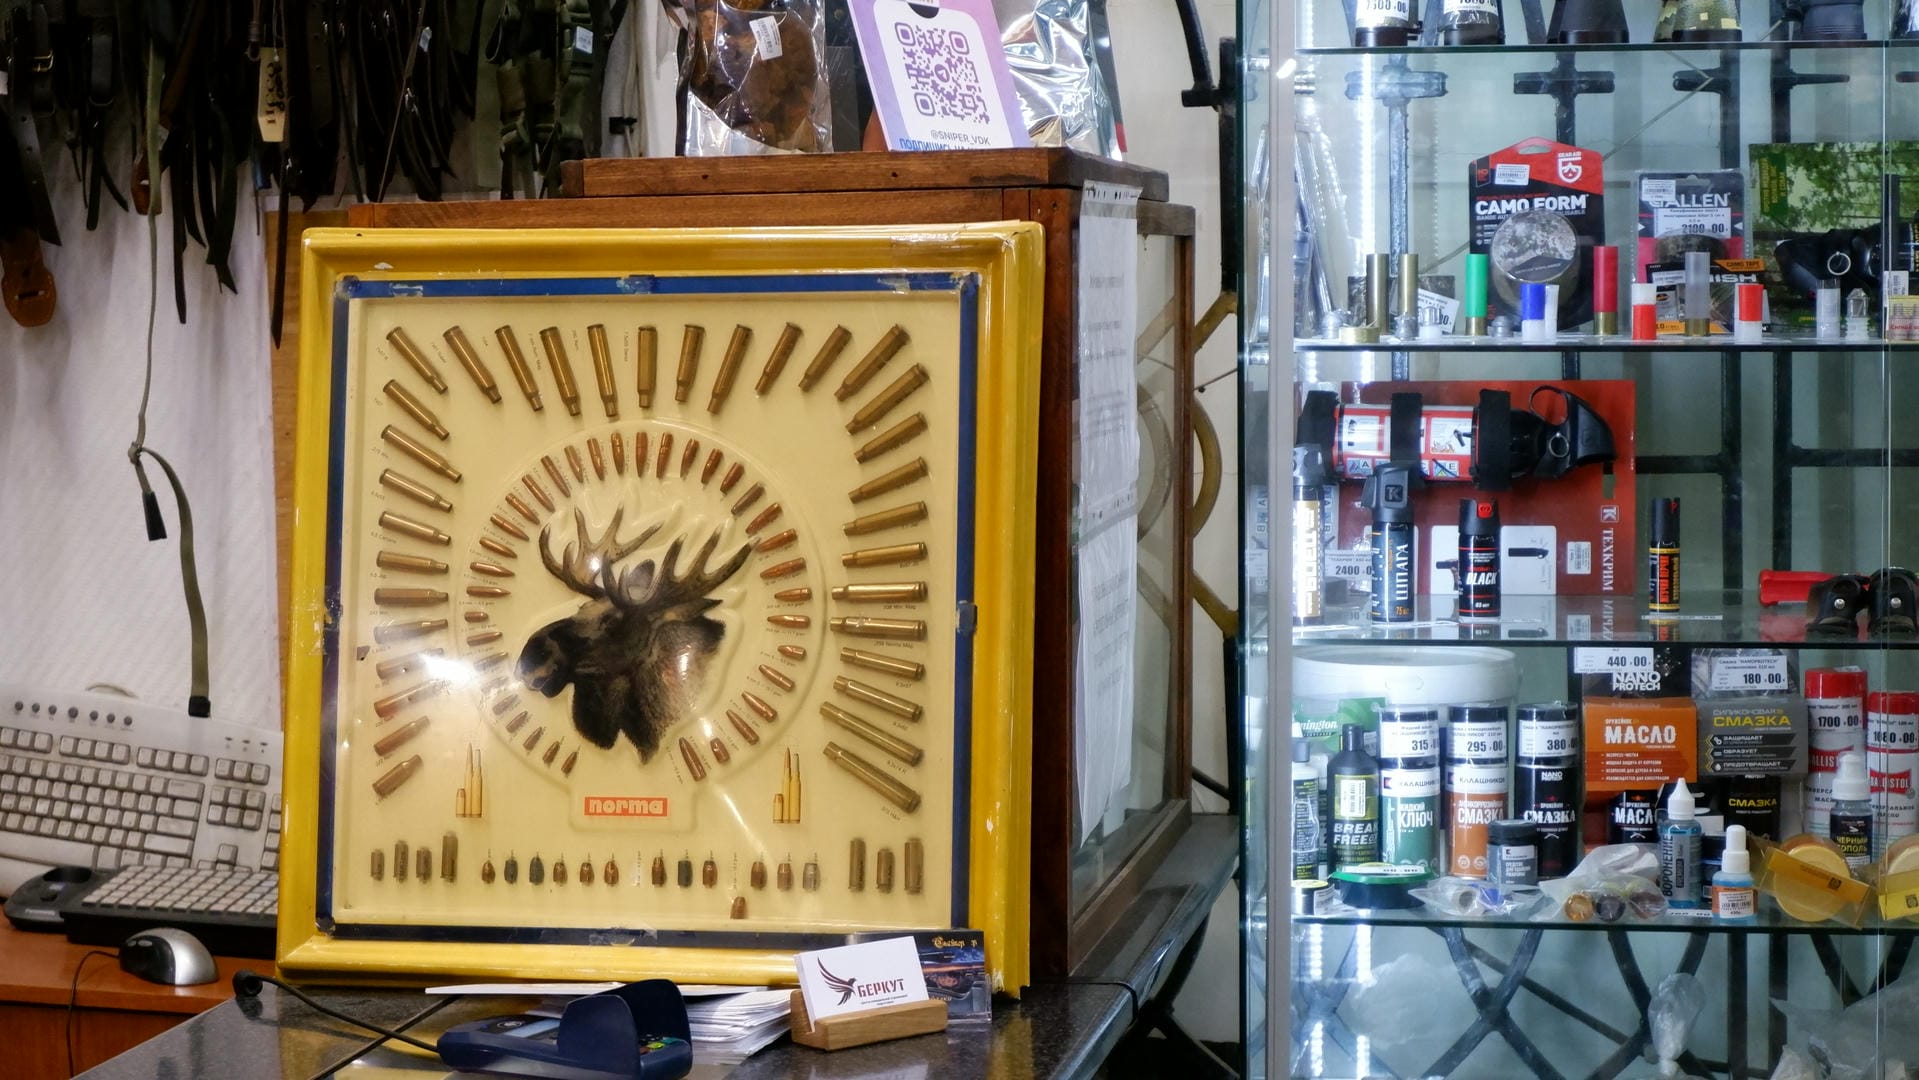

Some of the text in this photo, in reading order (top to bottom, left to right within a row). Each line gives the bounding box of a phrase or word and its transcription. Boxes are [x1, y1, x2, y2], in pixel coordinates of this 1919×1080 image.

[931, 130, 991, 146] @SNIPER_VDK
[1475, 198, 1530, 215] CAMO
[1534, 195, 1587, 211] FORM
[1711, 223, 1724, 233] 00
[1602, 527, 1614, 591] ТЕХКРИМ
[1335, 565, 1360, 575] 2400
[1396, 543, 1409, 601] ШПАГА
[1466, 572, 1498, 585] BLACK
[1607, 656, 1647, 667] 440 00
[1612, 671, 1661, 683] NANO
[1743, 673, 1781, 684] 180 00
[1612, 682, 1661, 691] PROTECH
[1301, 719, 1338, 732] ington
[1713, 715, 1791, 727] СМАЗКА
[1818, 715, 1859, 727] 1700 00
[1605, 725, 1676, 744] МАСЛО
[1903, 732, 1915, 743] 00
[1412, 740, 1429, 751] 315
[1467, 740, 1504, 752] 295 00
[1547, 739, 1566, 750] 380
[589, 799, 664, 814] norma
[1728, 798, 1777, 807] СМАЗКА
[1400, 811, 1433, 828] КЛЮЧ
[1458, 808, 1504, 825] СМАЗКА
[1523, 809, 1576, 824] СМАЗКА
[1615, 807, 1654, 824] МАСЛ
[1334, 834, 1368, 845] FREE
[1662, 834, 1673, 897] ВОРОНЕНИЕ
[857, 978, 904, 998] БЕРКУТ
